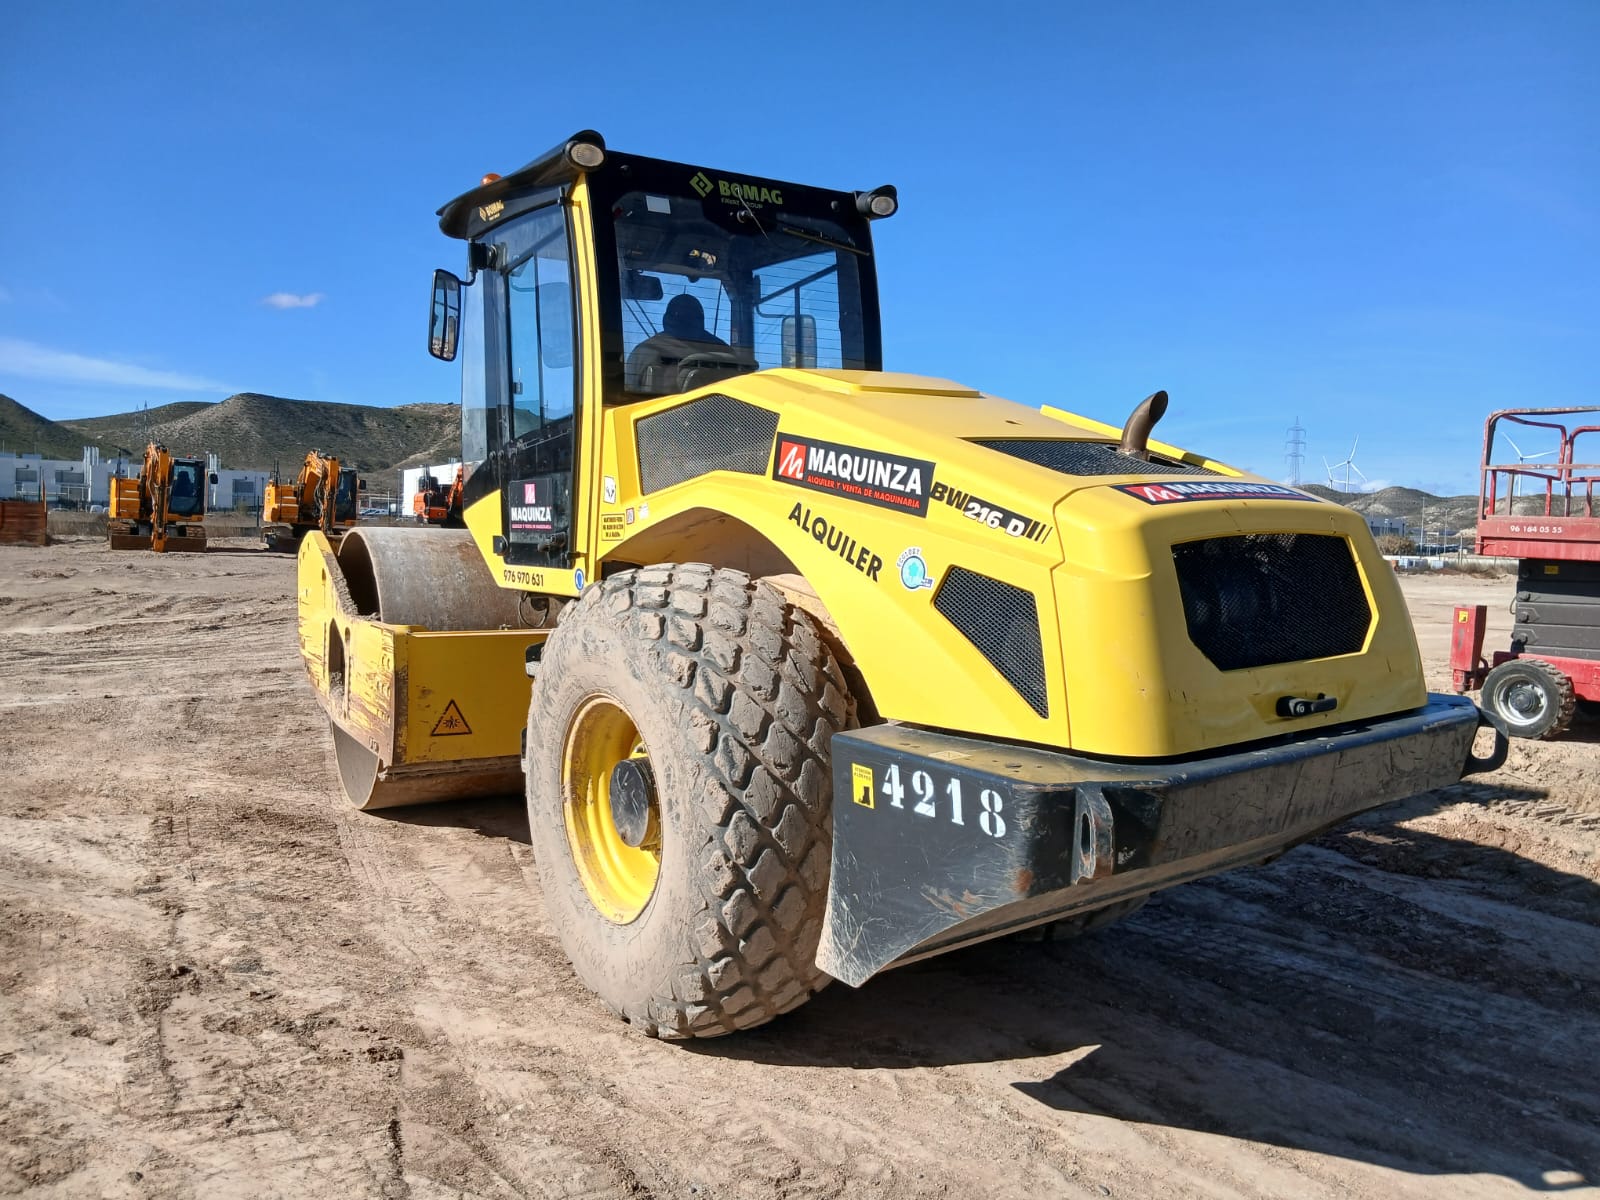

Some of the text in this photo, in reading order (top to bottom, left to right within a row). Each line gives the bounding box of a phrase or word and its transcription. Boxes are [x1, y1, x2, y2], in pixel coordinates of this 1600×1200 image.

[718, 180, 784, 205] BOMAG
[807, 446, 923, 496] MAQUINZA
[806, 474, 921, 509] ALQUILER Y VENTA DE MAQUINARIA
[510, 506, 552, 522] MAQUINZA
[787, 501, 883, 583] ALQUILER
[1510, 525, 1521, 533] 96
[1551, 526, 1563, 534] 55
[503, 569, 544, 587] 976 970 631
[881, 763, 1007, 838] 4218
